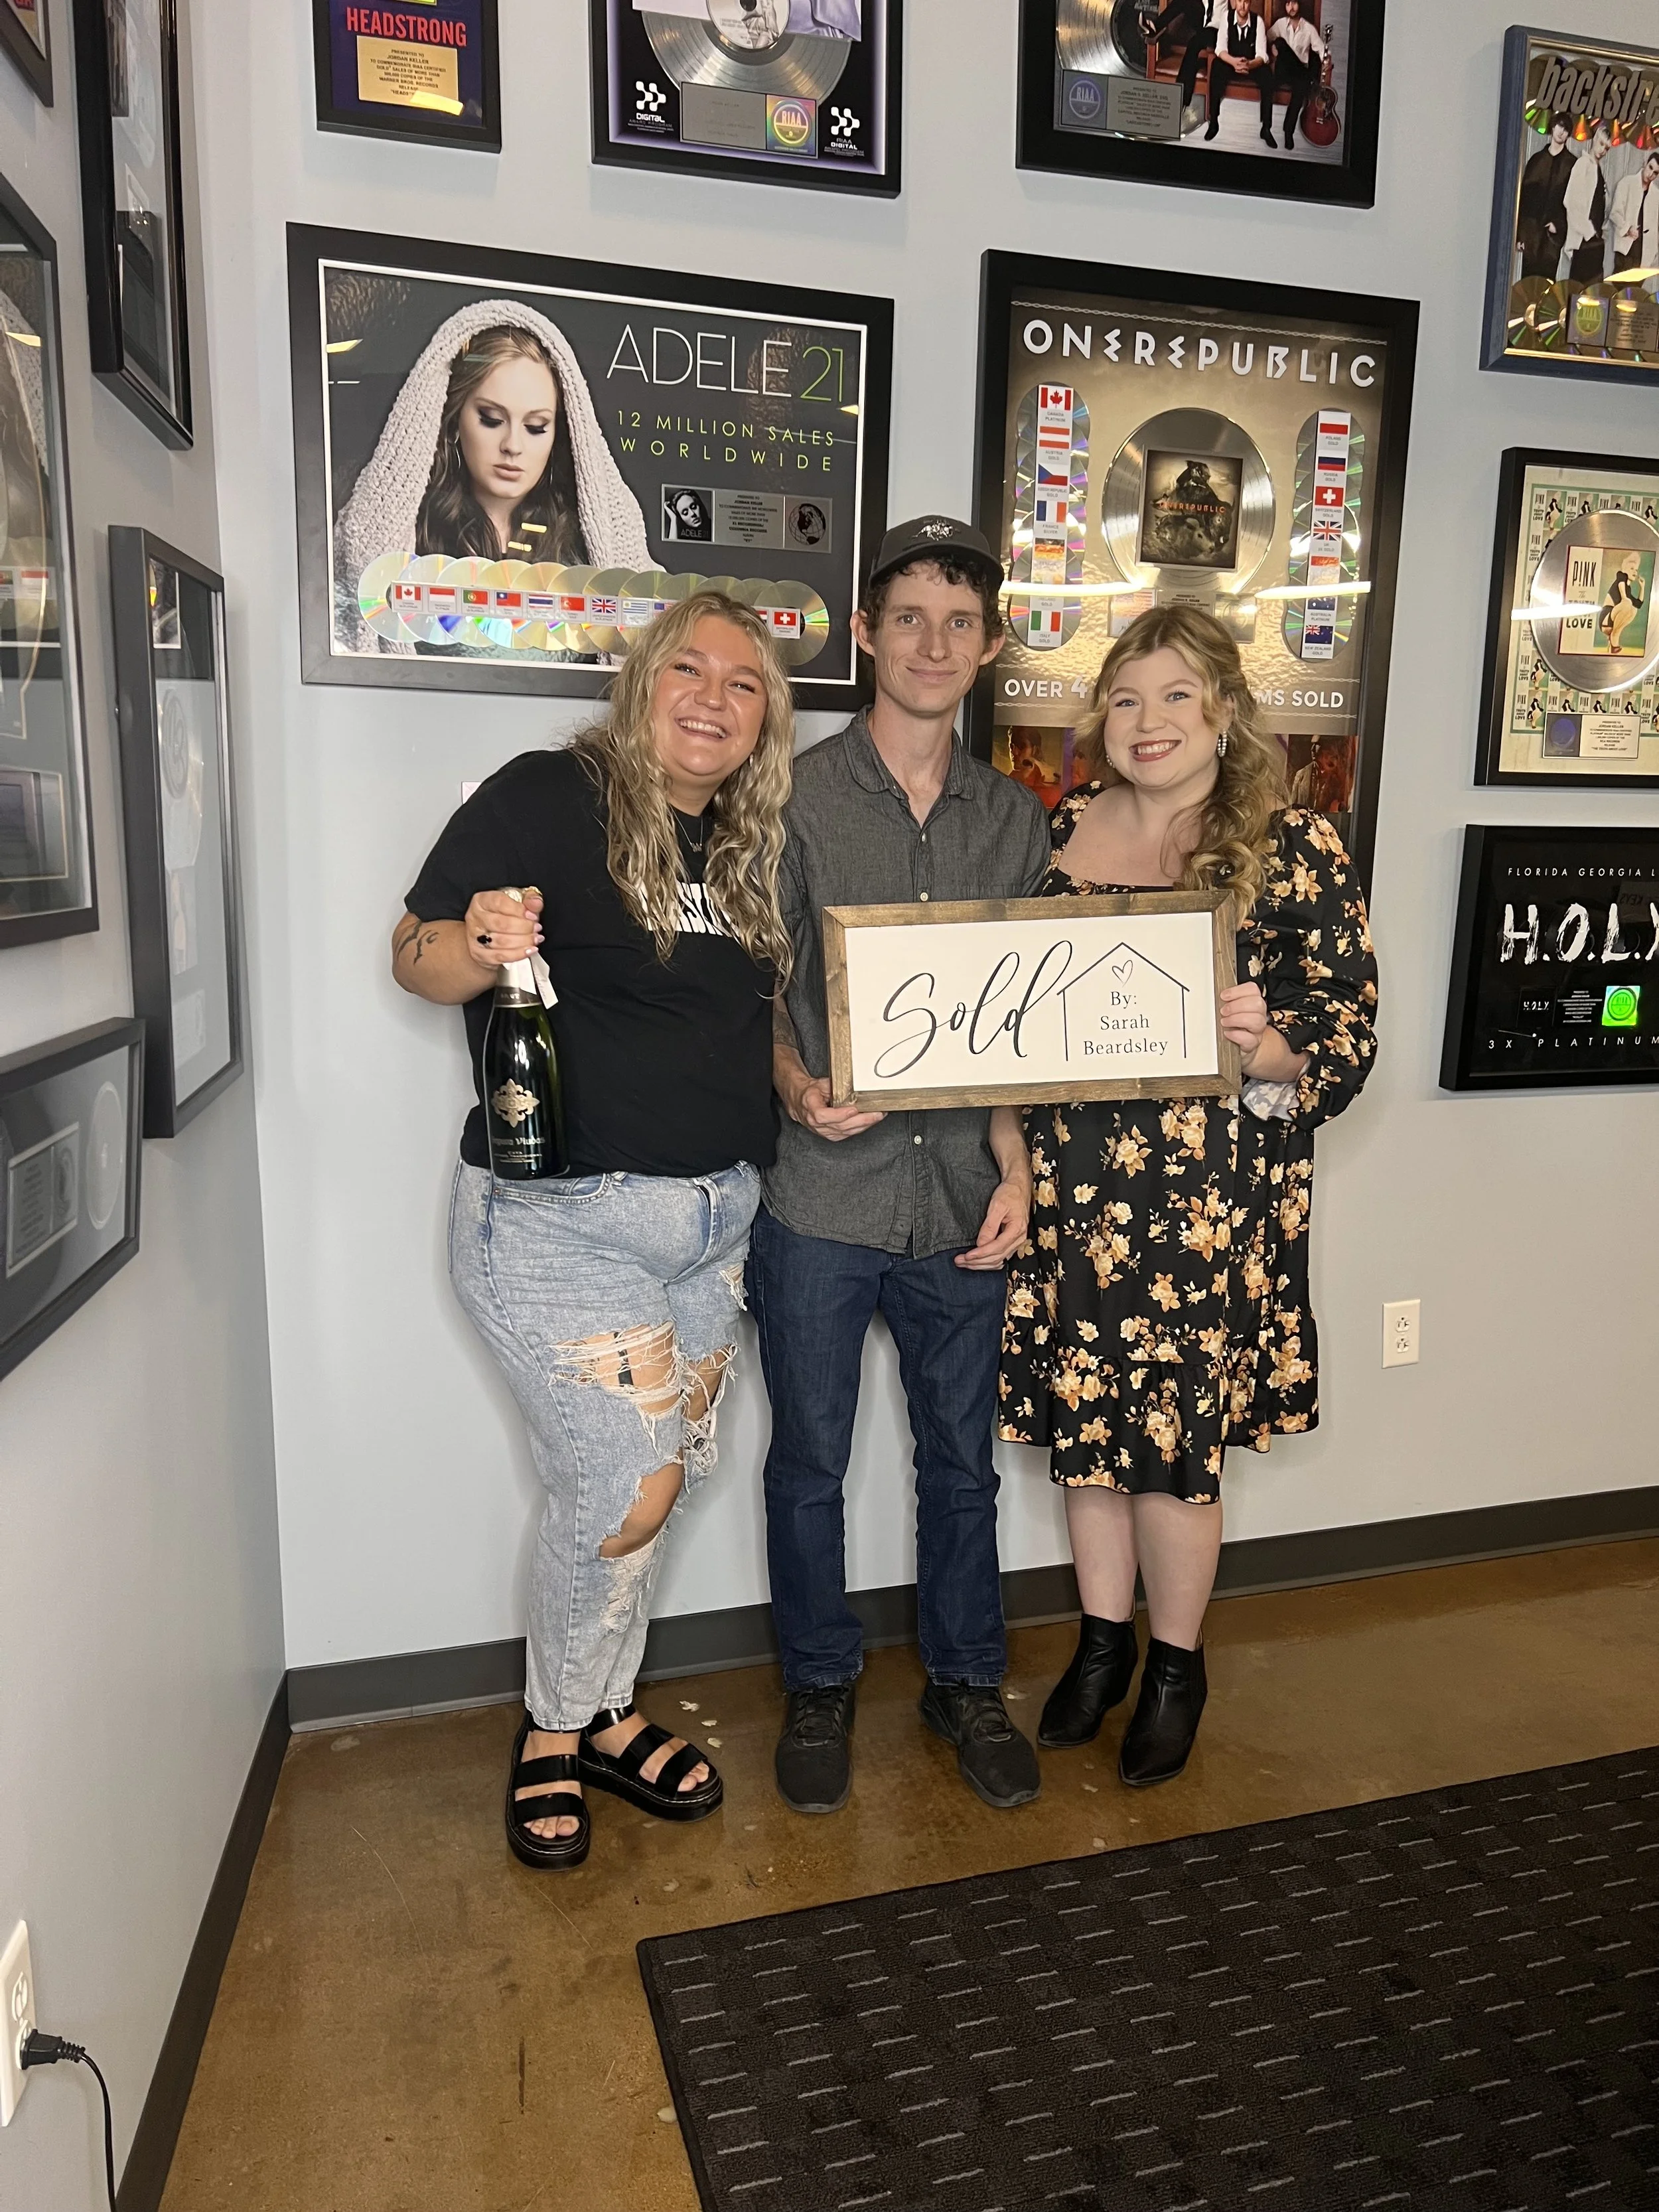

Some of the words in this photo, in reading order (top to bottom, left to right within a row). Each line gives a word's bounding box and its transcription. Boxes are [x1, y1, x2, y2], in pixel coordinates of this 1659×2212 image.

[346, 7, 467, 46] HEADSTRONG
[1076, 87, 1095, 102] RIAA
[636, 112, 666, 123] DIGITAL
[782, 110, 802, 127] RIAA
[830, 141, 858, 150] DIGITAL
[1023, 319, 1376, 388] ONEREPUBLIC
[606, 324, 792, 398] ADELE
[800, 345, 845, 403] 21
[618, 410, 641, 428] 12
[656, 415, 754, 439] MILLION
[768, 426, 833, 447] SALES
[620, 437, 831, 472] WORLDWIDE
[680, 528, 702, 538] ADELE
[1572, 561, 1597, 587] P!NK
[1565, 618, 1593, 629] LOVE
[1004, 678, 1063, 698] OVER
[1070, 676, 1088, 699] 4
[1291, 690, 1344, 708] SOLD
[1508, 867, 1568, 877] FLORIDA
[1578, 867, 1641, 877] GEORGIA
[1110, 991, 1137, 1009] By:
[873, 940, 1073, 1079] Sold
[1100, 1013, 1150, 1031] Sarah
[1083, 1037, 1169, 1056] Beardsley
[1537, 1036, 1659, 1049] PLATINUM
